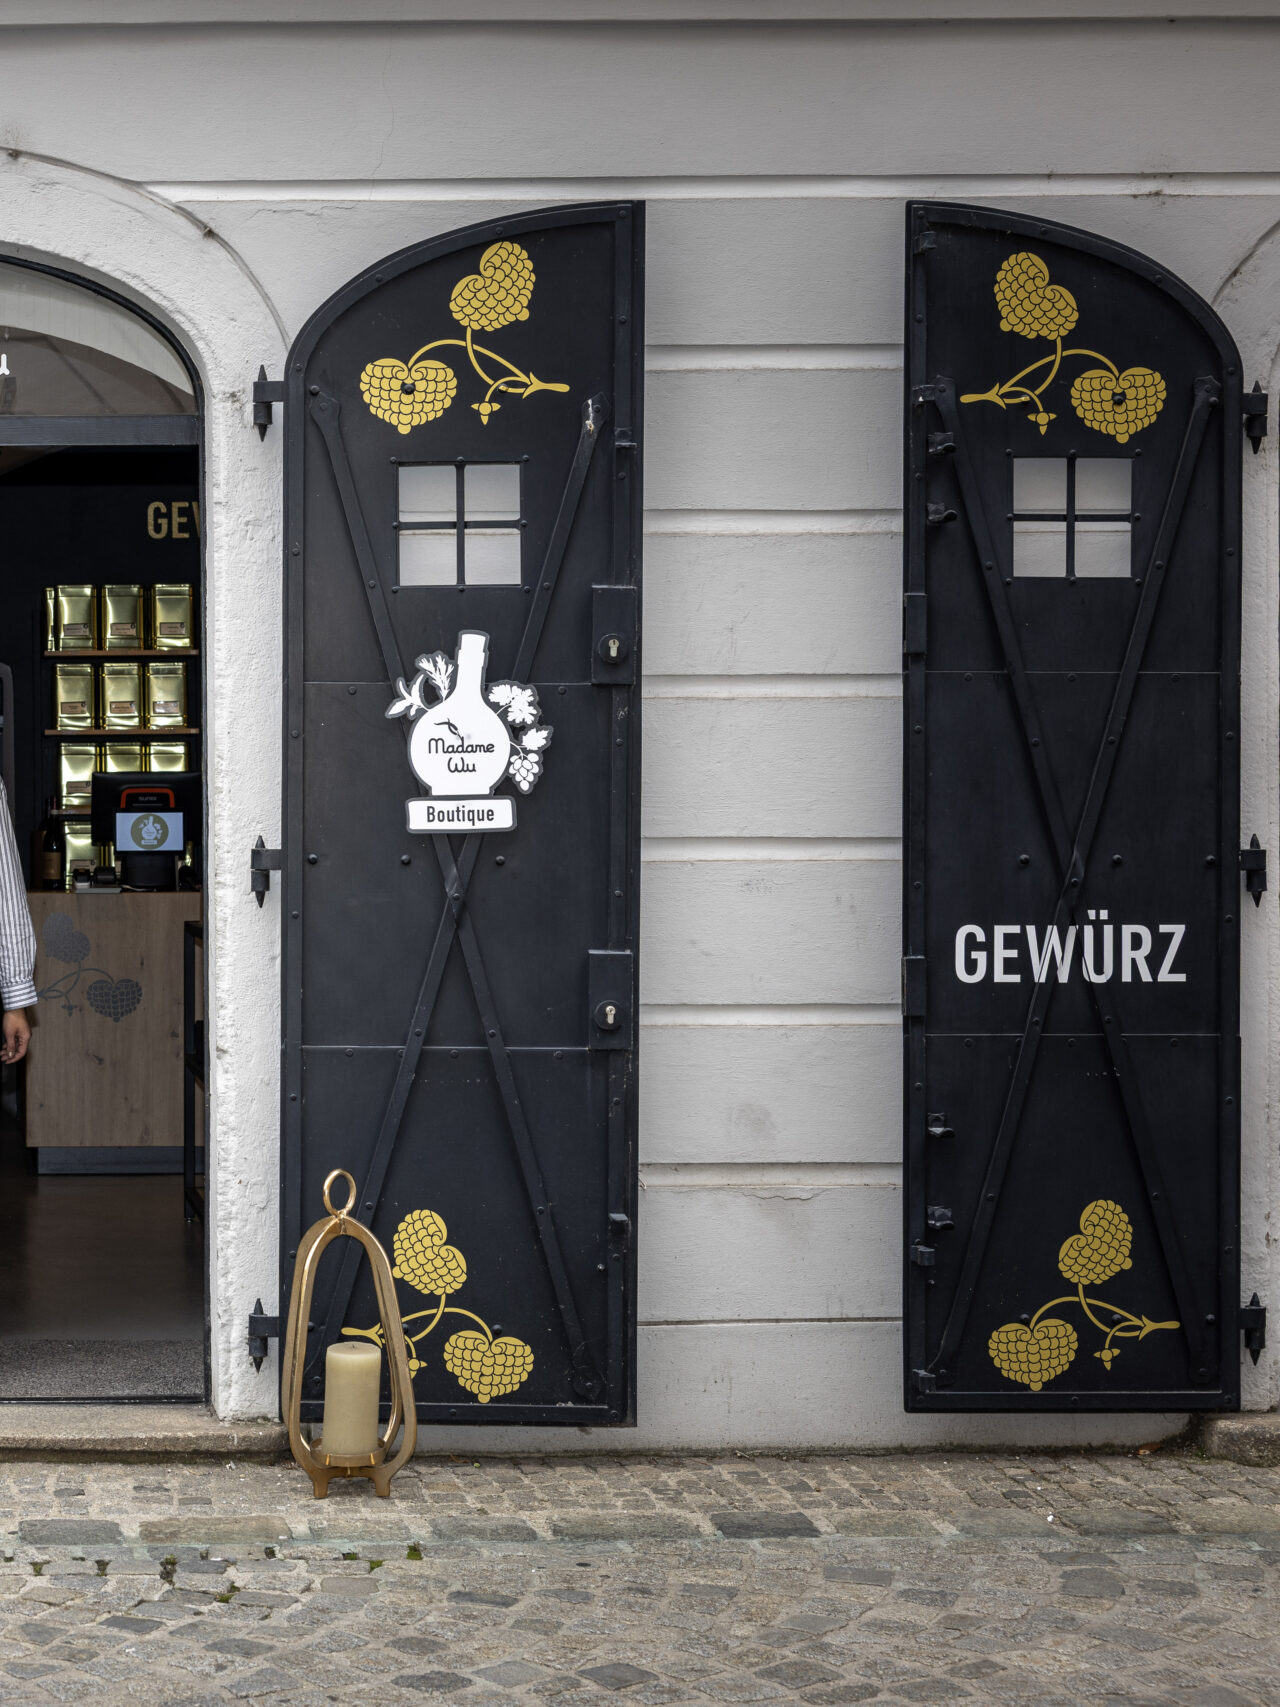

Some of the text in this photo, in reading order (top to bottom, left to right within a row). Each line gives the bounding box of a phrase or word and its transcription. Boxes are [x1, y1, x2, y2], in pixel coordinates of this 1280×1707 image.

[428, 737, 495, 754] Madame
[447, 756, 476, 773] Wu
[426, 805, 495, 826] Boutique
[954, 909, 1187, 984] GEWÜRZ
